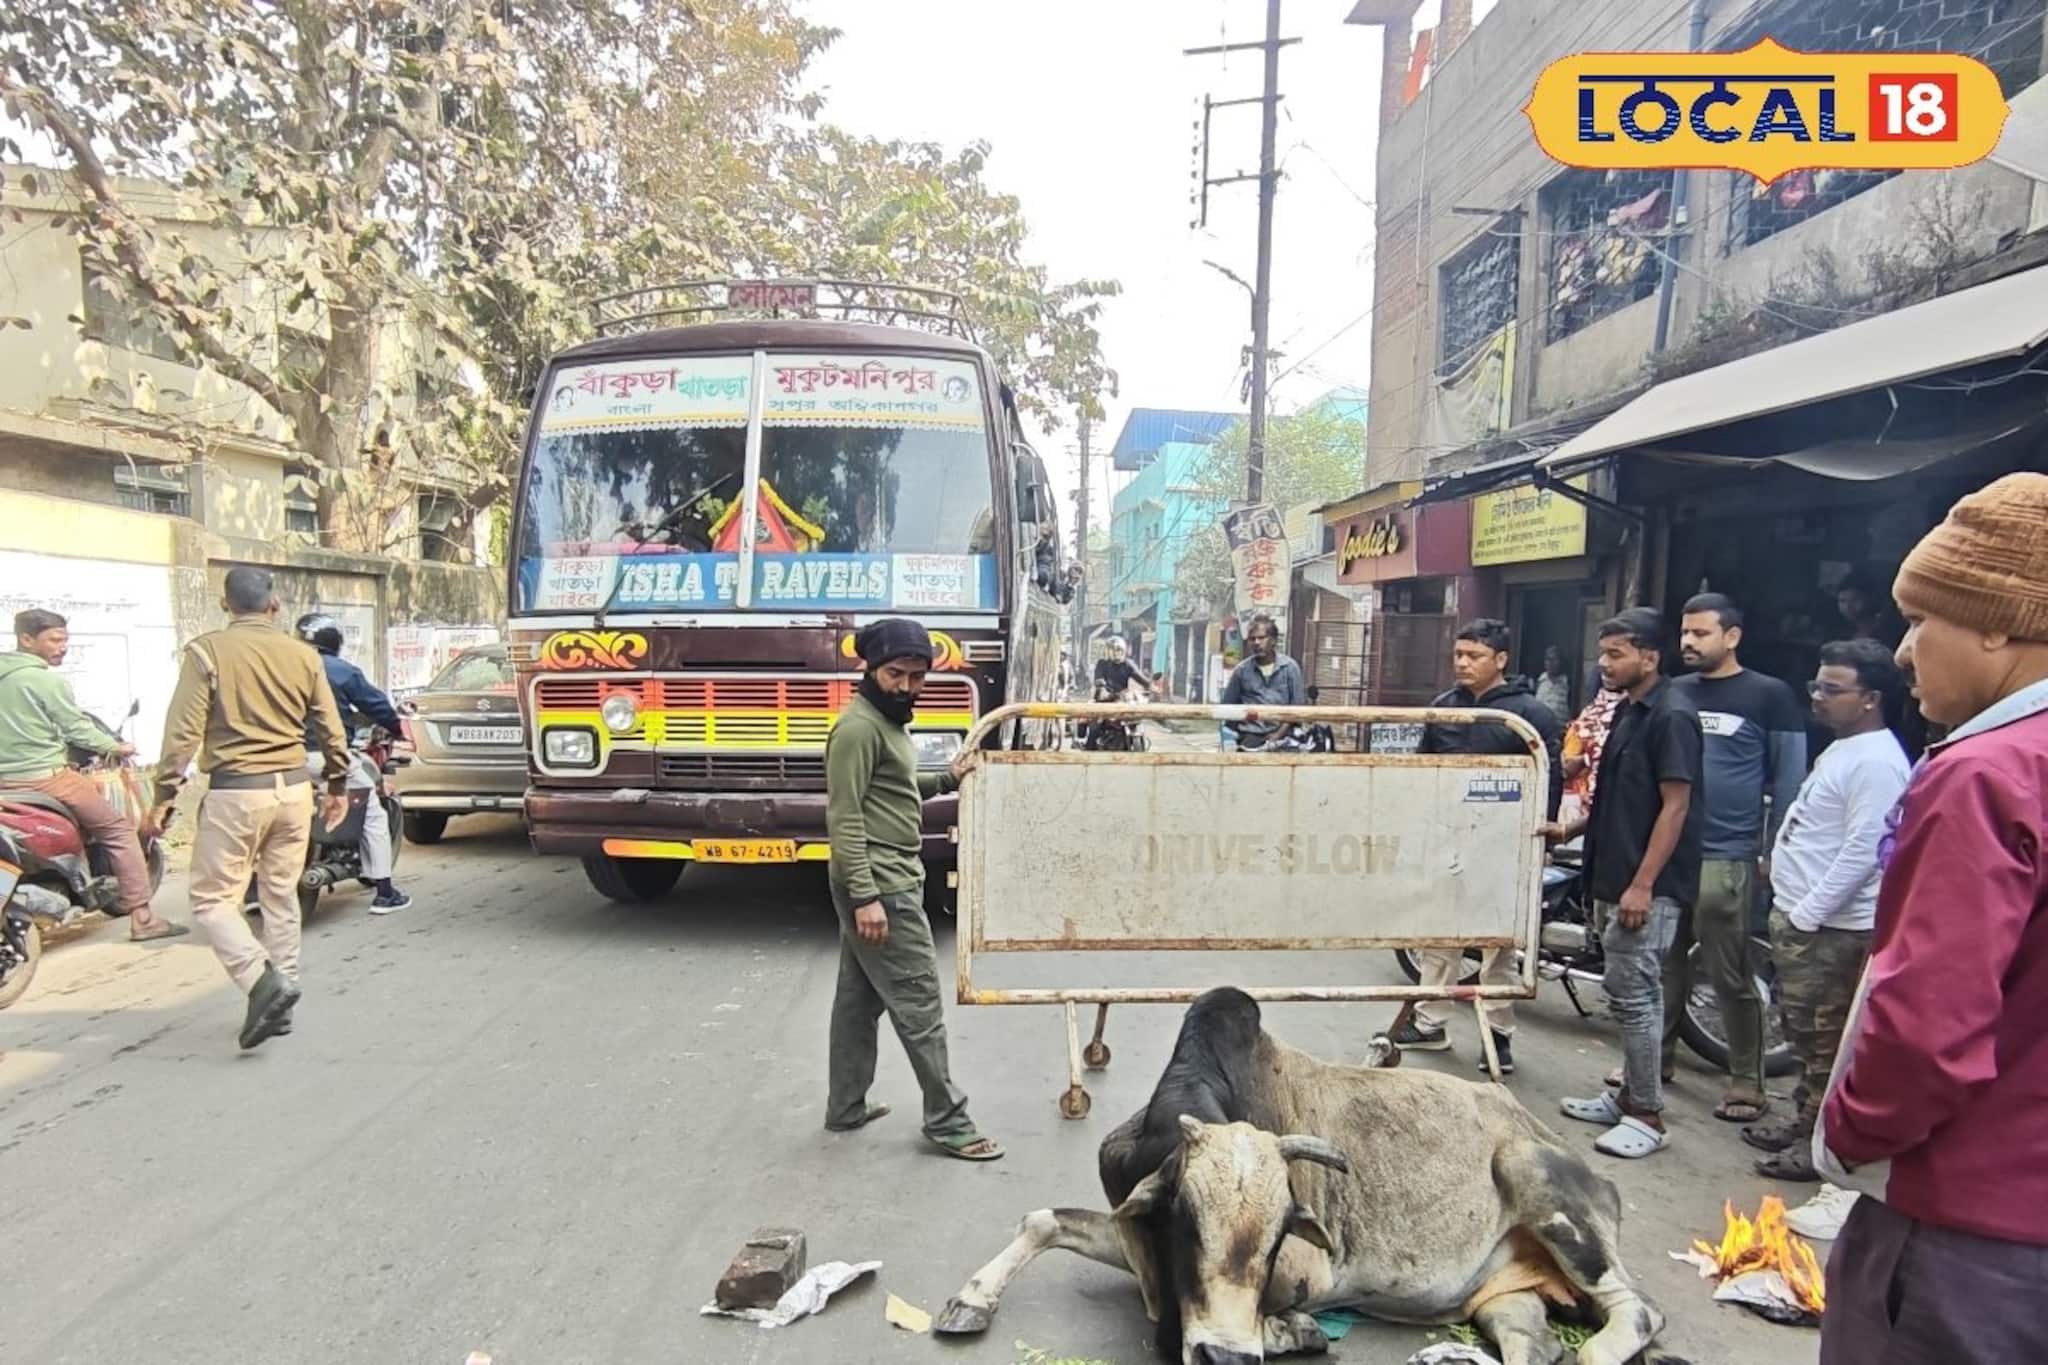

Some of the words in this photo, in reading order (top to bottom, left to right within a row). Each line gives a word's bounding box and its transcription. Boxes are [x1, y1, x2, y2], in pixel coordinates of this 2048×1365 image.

[577, 368, 682, 399] বাঁকুড়া
[678, 376, 749, 401] খাতড়া
[619, 562, 705, 602] ISHA
[704, 845, 723, 858] WB
[1279, 832, 1401, 876] SLOW
